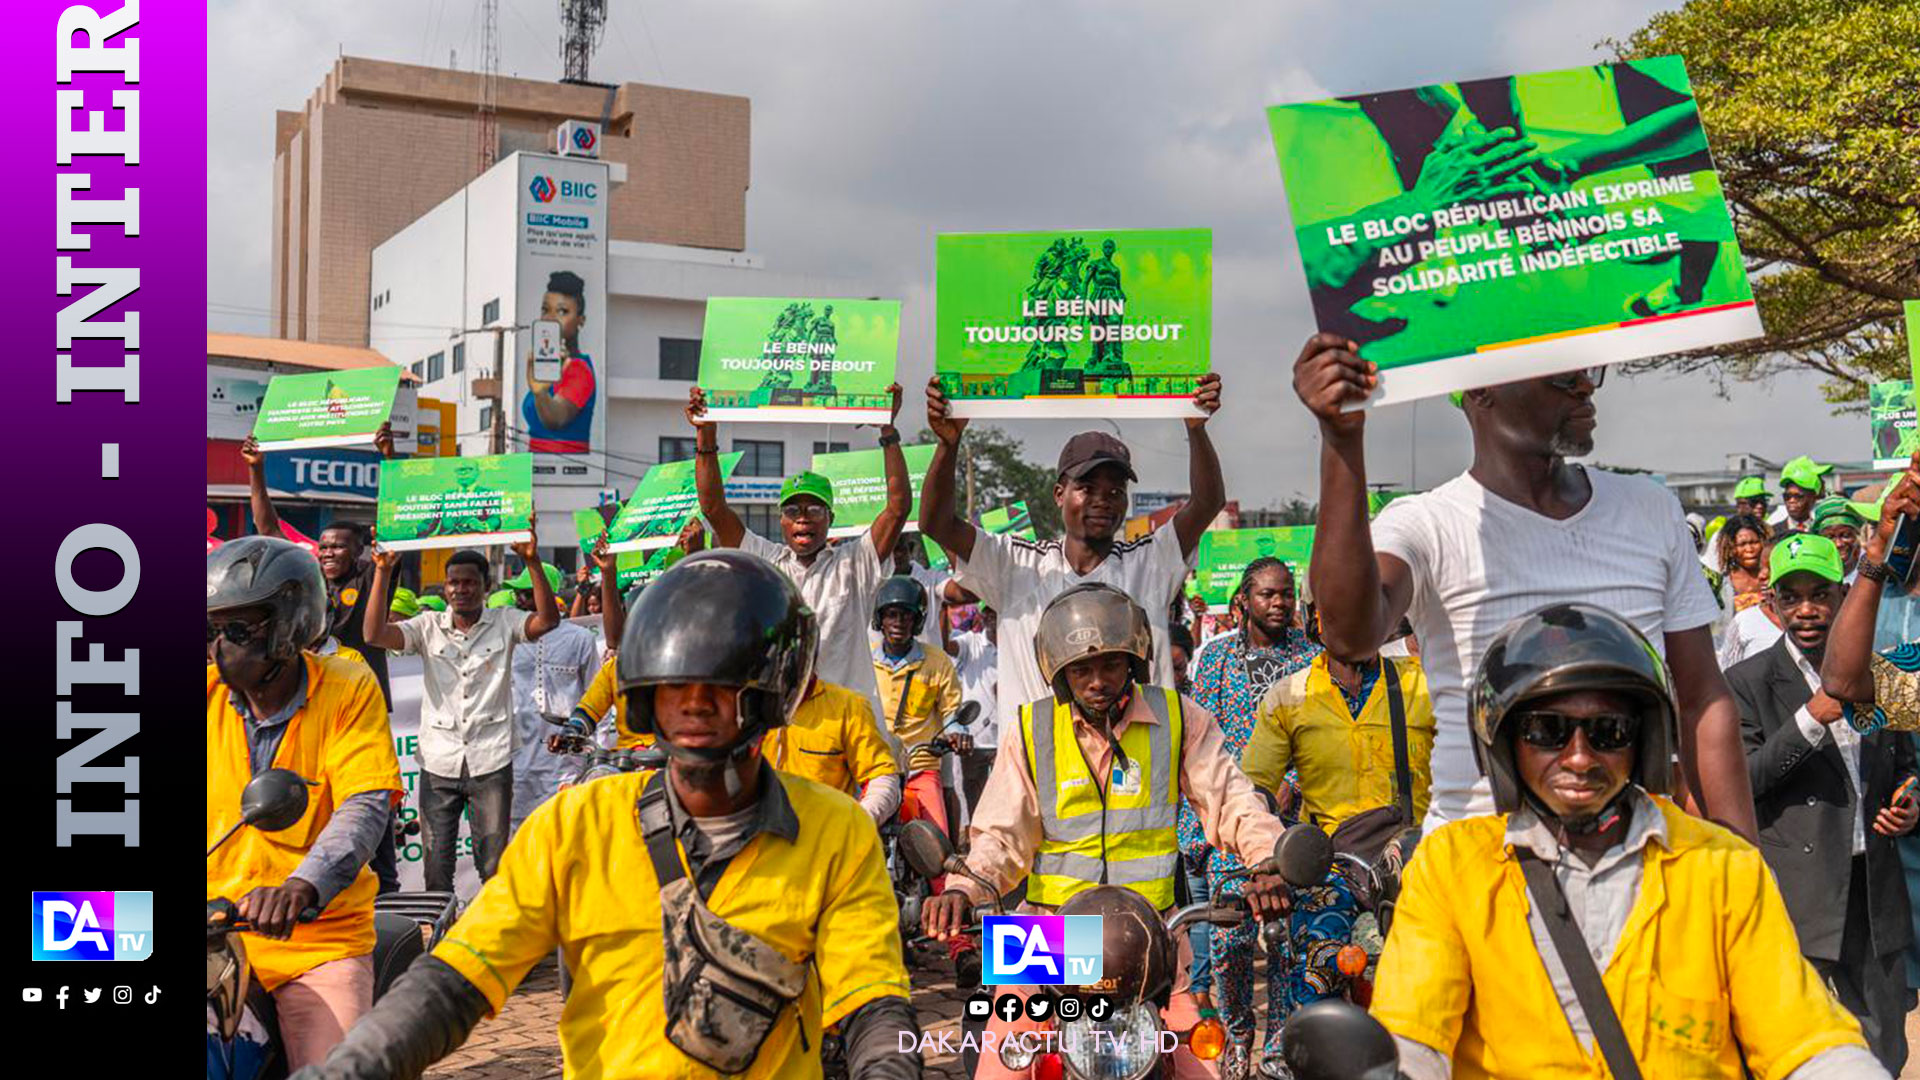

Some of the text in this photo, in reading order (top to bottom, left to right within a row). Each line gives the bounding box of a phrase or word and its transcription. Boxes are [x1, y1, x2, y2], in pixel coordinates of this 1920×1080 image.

[560, 180, 598, 199] BIIC
[1326, 174, 1695, 246] LE BLOC RÉPUBLICAIN EXPRIME
[527, 228, 544, 237] Plus
[1378, 206, 1664, 268] AU PEUPLE BÉNINOIS SA
[1372, 231, 1683, 297] SOLIDARITÉ INDÉFECTIBLE
[1022, 295, 1125, 317] LE BÉNIN
[965, 323, 1183, 344] TOUJOURS DEBOUT
[763, 339, 837, 354] LE BÉNIN
[720, 358, 876, 373] TOUJOURS DEBOUT
[287, 400, 298, 408] LE
[290, 457, 380, 488] TECNO
[406, 490, 505, 503] LE BLOC RÉPUBLICAIN
[853, 485, 888, 495] DÉFENS
[397, 498, 513, 512] SOUTIENT SANS FAILLE LE
[394, 506, 515, 521] PRÉSIDENT PATRICE TALON
